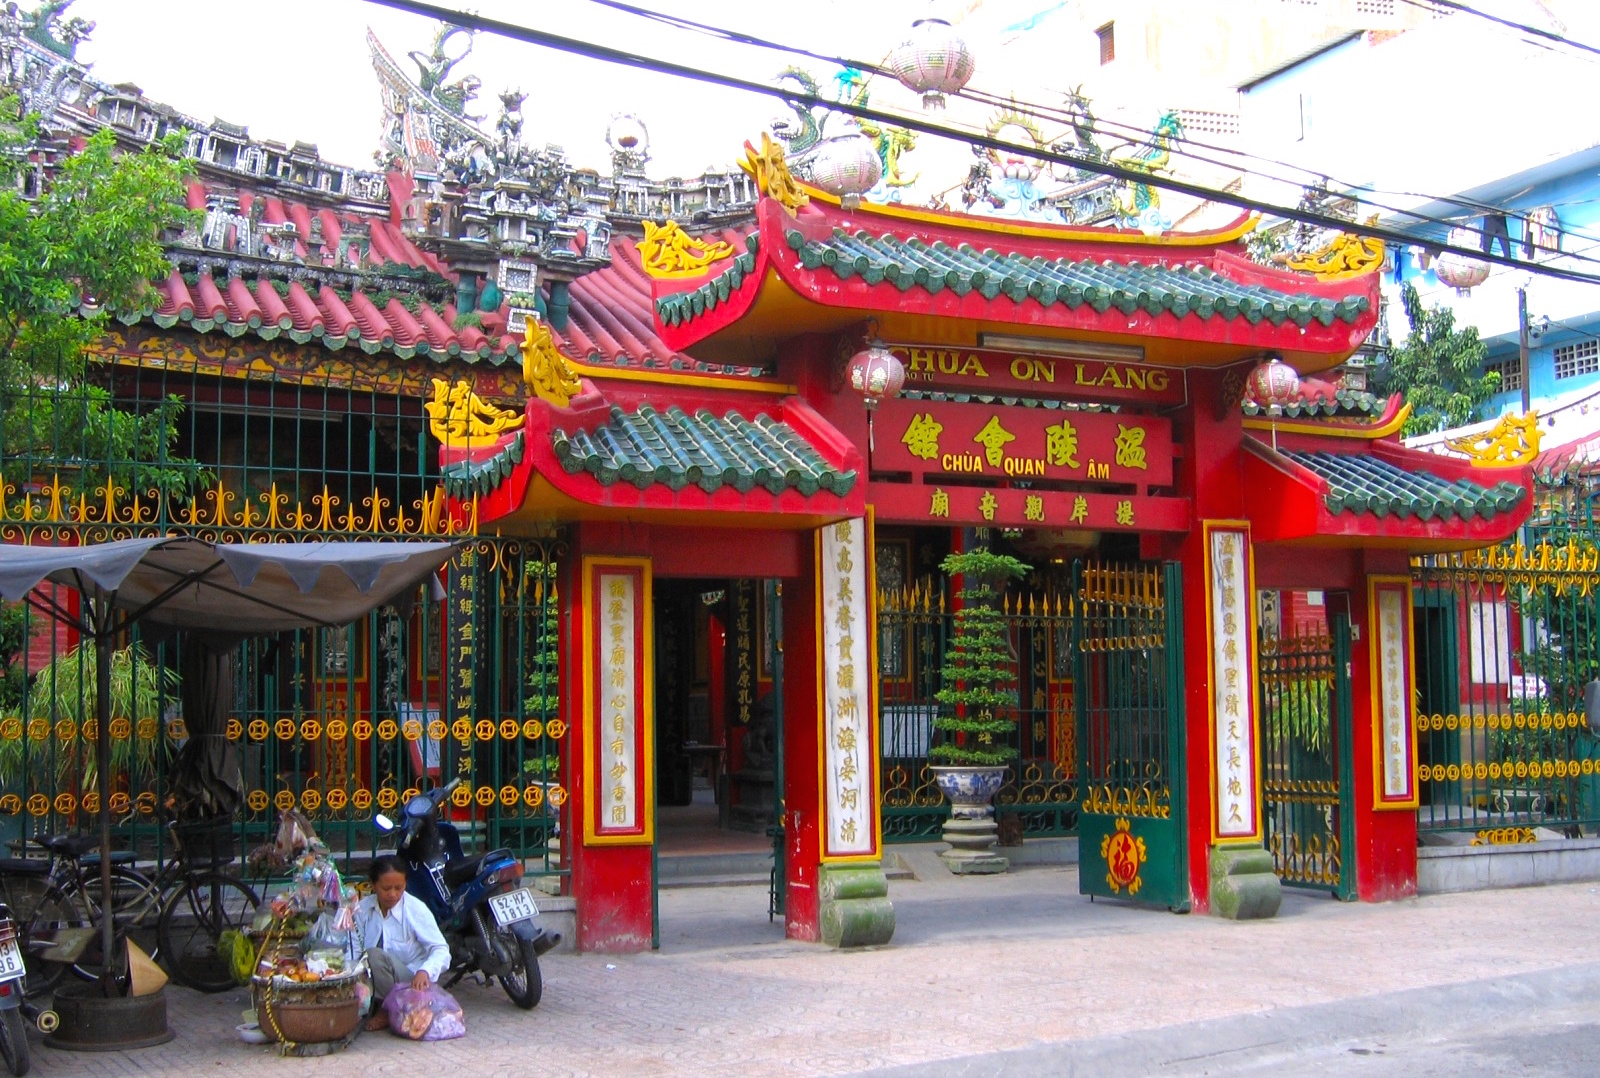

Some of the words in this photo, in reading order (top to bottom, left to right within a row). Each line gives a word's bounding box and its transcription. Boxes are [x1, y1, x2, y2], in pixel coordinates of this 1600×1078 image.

[1075, 362, 1170, 391] LĂNG
[942, 451, 983, 473] CHÙA
[1004, 457, 1045, 476] QUAN
[1087, 459, 1110, 479] ÂM
[502, 904, 531, 920] 1813
